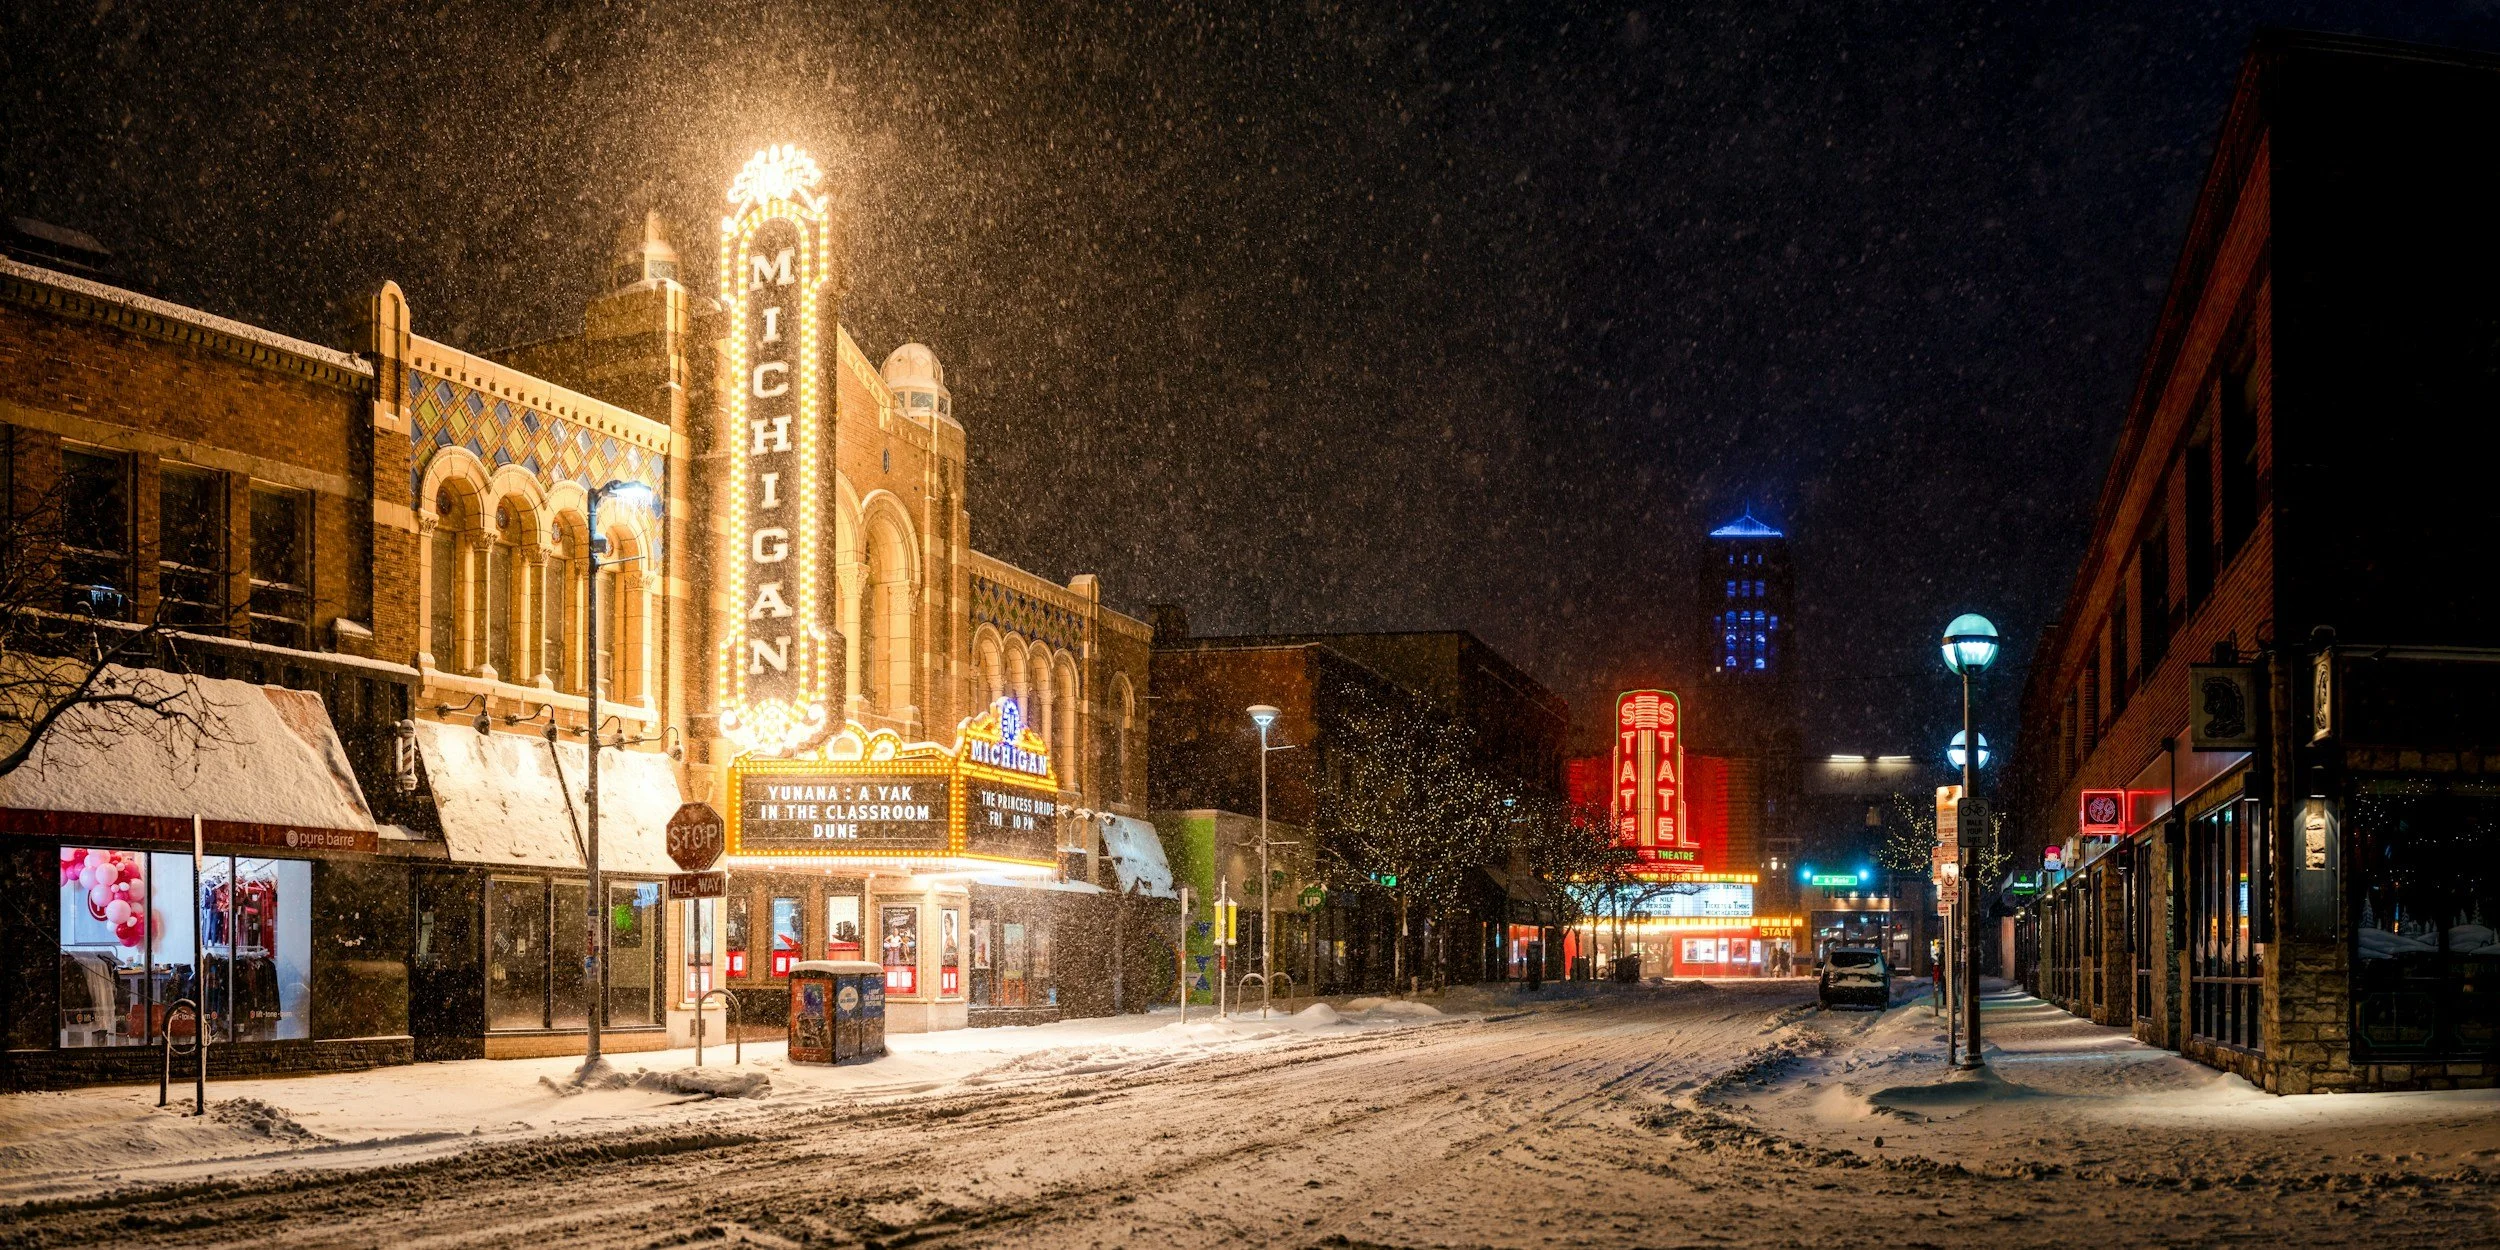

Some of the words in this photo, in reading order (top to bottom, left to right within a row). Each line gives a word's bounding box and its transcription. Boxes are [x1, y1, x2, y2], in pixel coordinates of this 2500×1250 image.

[748, 246, 795, 675] MICHIGAN
[970, 738, 1048, 777] MICHIGAN
[1620, 702, 1636, 840] STATE
[1657, 702, 1675, 840] STATE
[768, 785, 838, 801] YUNANA
[859, 786, 870, 801] A
[878, 786, 912, 801] YAK
[761, 805, 778, 820] IN
[787, 805, 818, 820] THE
[825, 805, 930, 820] CLASSROOM
[982, 791, 996, 807] THE
[997, 793, 1032, 814] PRINCESS
[1034, 800, 1055, 817] BRIDE
[989, 811, 1002, 828] FRI
[1013, 814, 1021, 829] 10
[1023, 815, 1034, 830] PM
[300, 832, 324, 847] pure
[326, 830, 355, 847] barre
[669, 823, 718, 851] STOP
[813, 823, 858, 839] DUNE
[1657, 850, 1695, 861] THEATRE
[670, 879, 691, 895] ALL
[698, 877, 720, 893] WAY
[1303, 896, 1321, 907] UP
[1761, 927, 1794, 937] STATE
